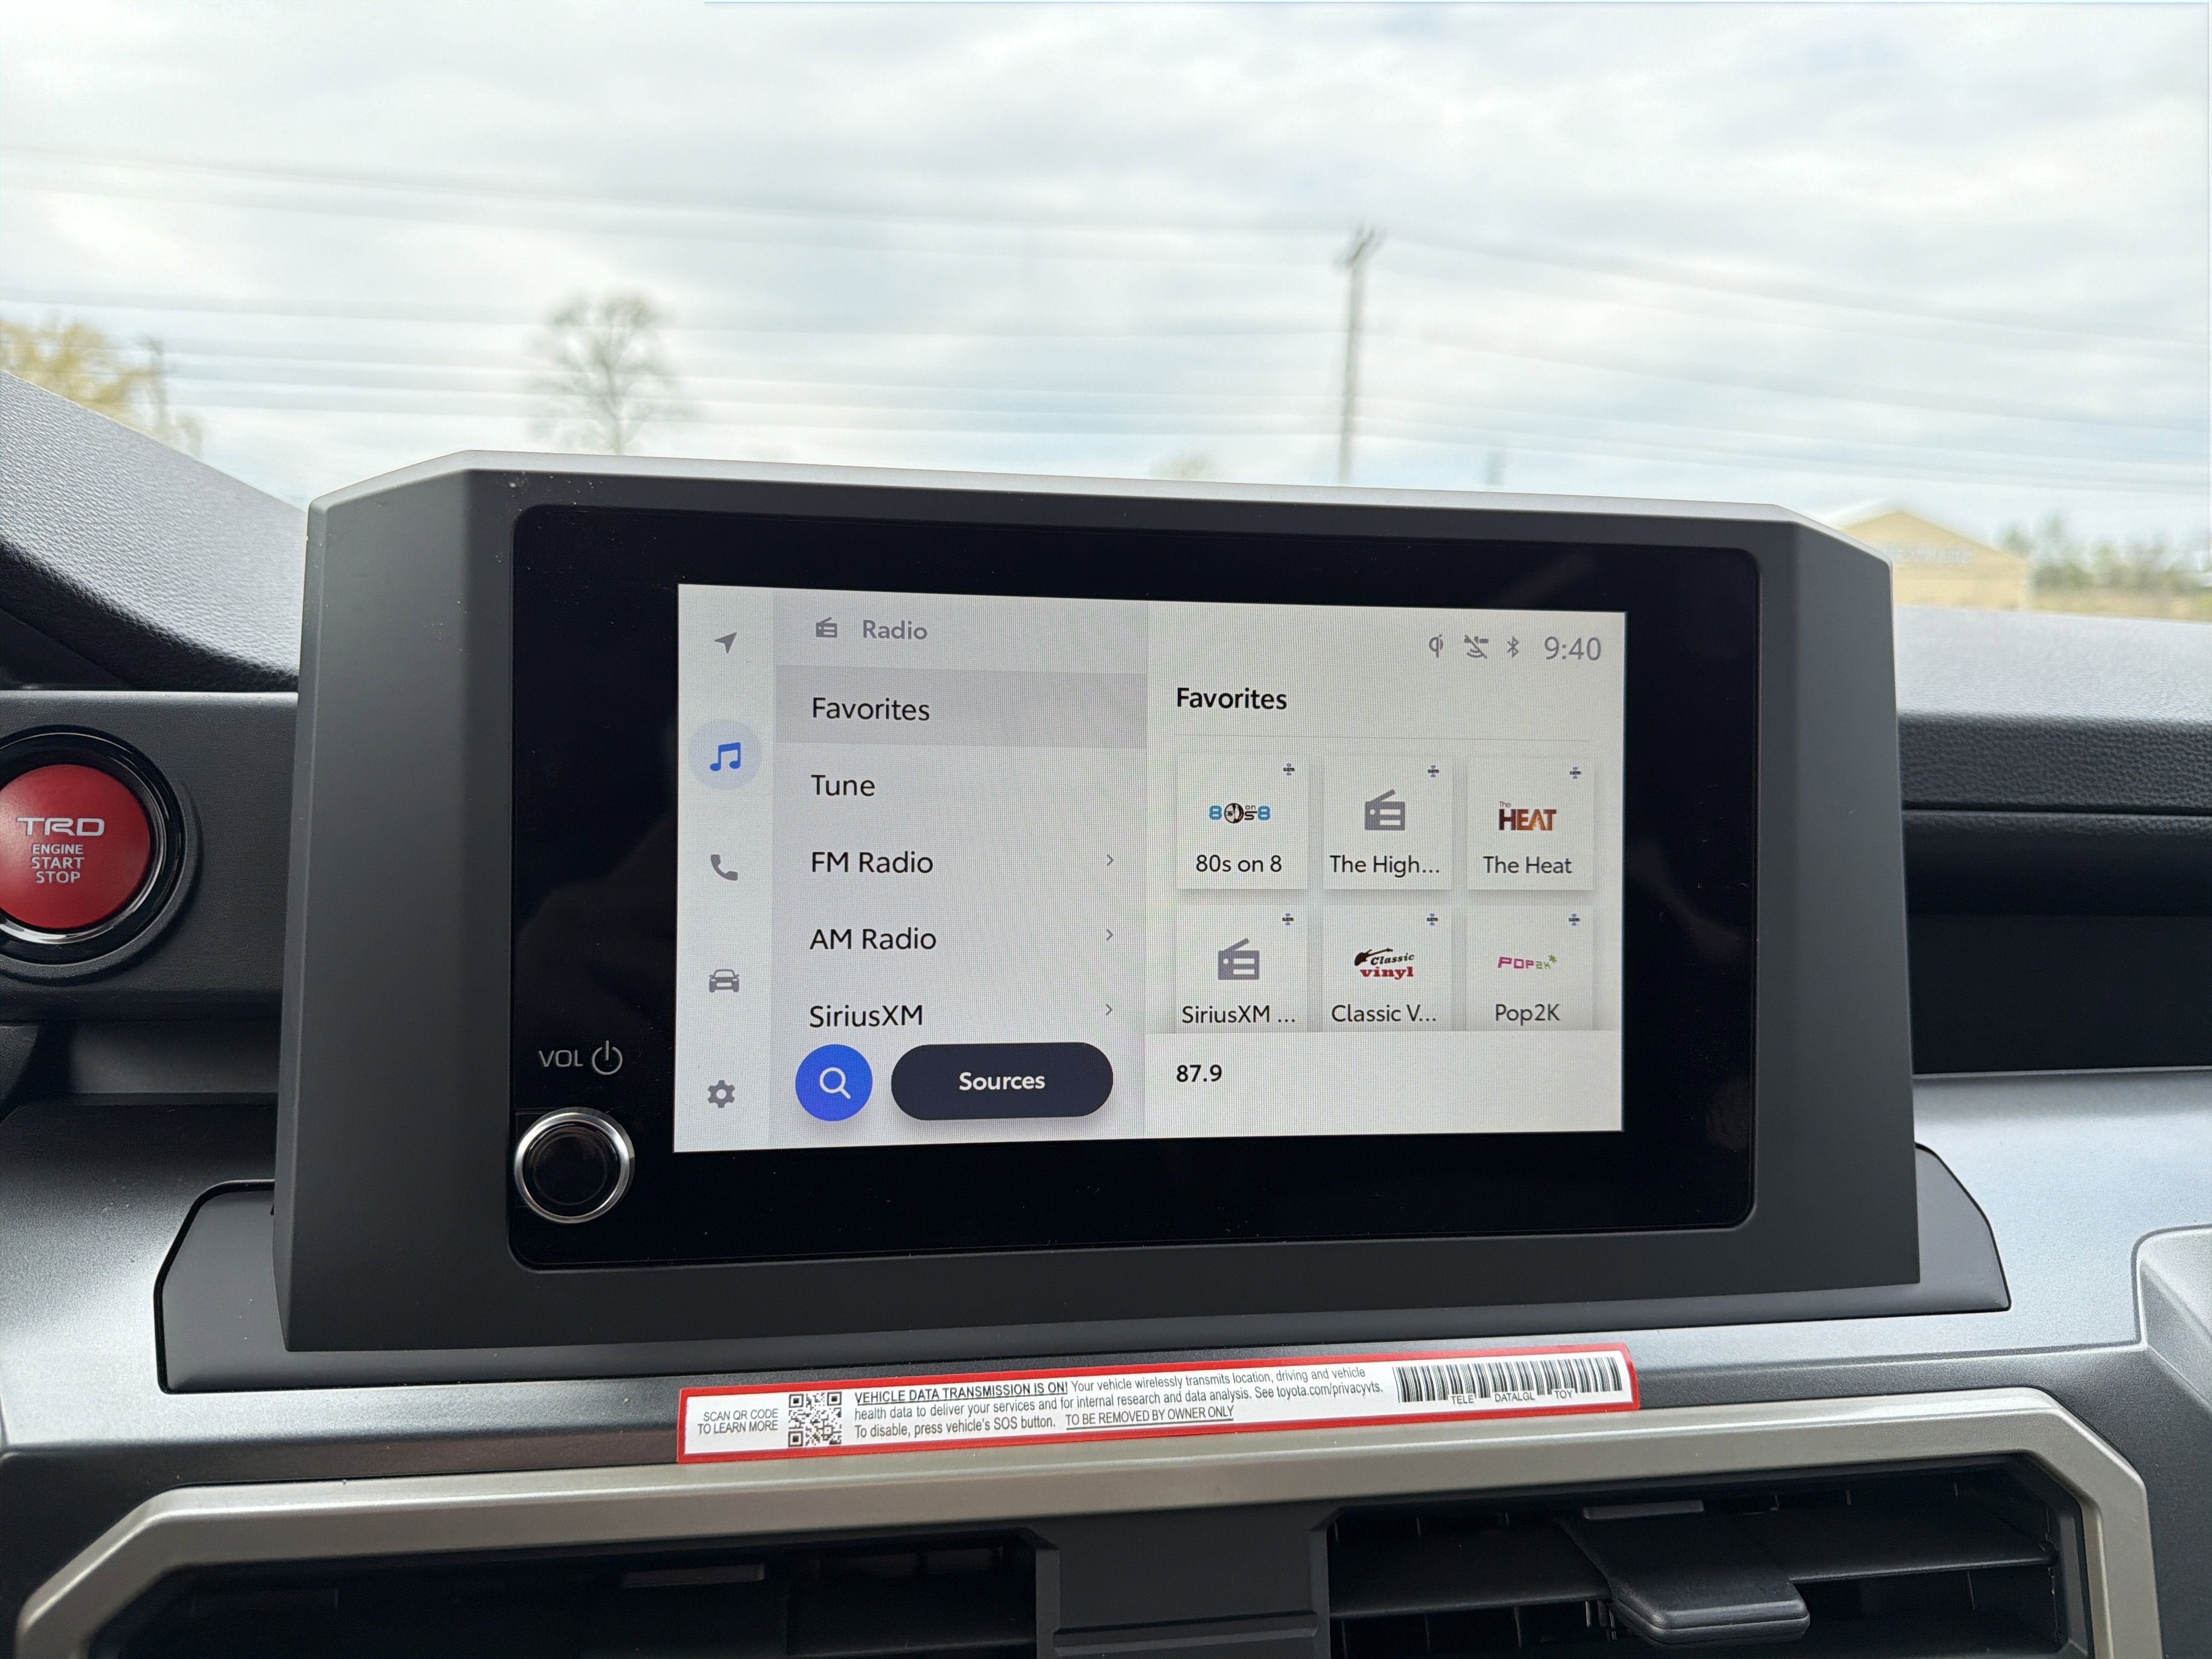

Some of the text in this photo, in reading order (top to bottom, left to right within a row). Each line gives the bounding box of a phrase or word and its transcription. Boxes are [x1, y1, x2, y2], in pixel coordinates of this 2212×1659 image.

[862, 619, 928, 641] Radio
[1544, 636, 1601, 661] 9:40
[1176, 687, 1287, 710] Favorites
[812, 696, 930, 721] Favorites
[811, 775, 876, 797] Tune
[16, 817, 105, 837] TRD
[1498, 809, 1557, 831] HEAT
[32, 844, 84, 855] ENGINE
[31, 856, 84, 869] START
[812, 850, 934, 873] FM Radio
[1196, 854, 1282, 872] 80s on 8
[1329, 855, 1366, 873] The
[1483, 856, 1572, 874] The Heat
[36, 871, 81, 884] STOP
[809, 927, 937, 950] AM Radio
[1370, 952, 1414, 966] Classic
[1360, 966, 1414, 980] vinyl
[809, 1005, 923, 1028] SiriusXM
[1182, 1005, 1270, 1023] SiriusXM
[1331, 1004, 1402, 1022] Classic
[1495, 1003, 1560, 1026] Pop2K
[538, 1049, 584, 1068] VOL
[958, 1071, 1046, 1091] Sources
[1176, 1064, 1222, 1082] 87.9
[855, 1366, 1365, 1404] VEHICLE DATA TRANSMISSION IS ON! Your vehicle wirelessly transmits location, driving and vehicle
[855, 1381, 1384, 1421] health data to deliver your services and for internal research and data analysis. See toyota.com/privacyvts.
[1451, 1388, 1573, 1404] TELE DATALGL TOY
[703, 1408, 778, 1422] SCAN QR CODE
[855, 1404, 1234, 1438] To disable, press vehicle's SOS button. TO BE REMOVED BY OWNER ONLY
[697, 1420, 778, 1435] TO LEARN MORE
